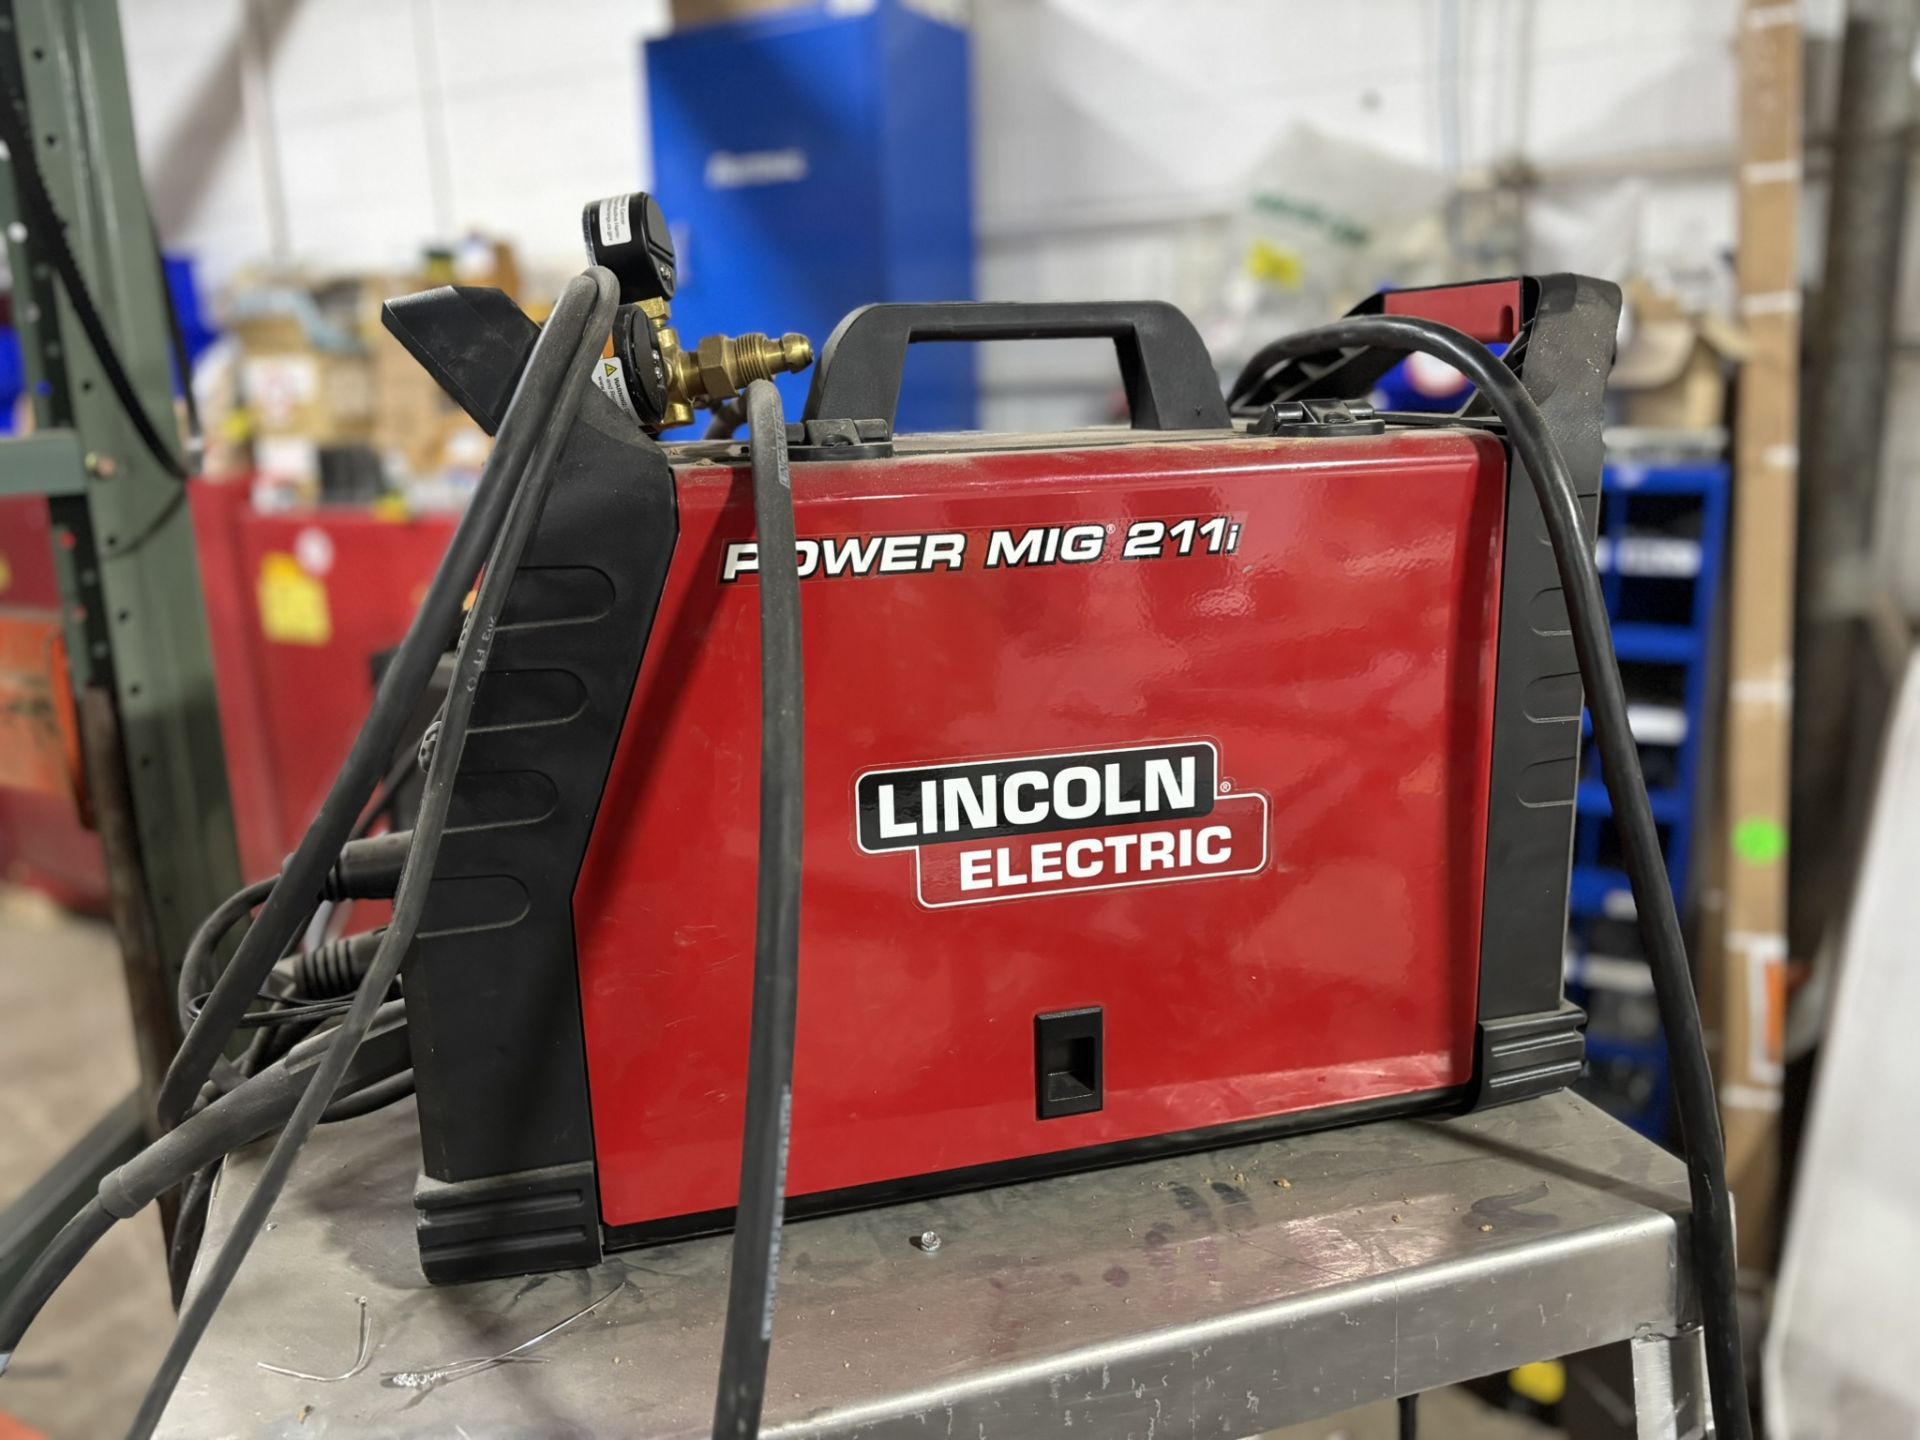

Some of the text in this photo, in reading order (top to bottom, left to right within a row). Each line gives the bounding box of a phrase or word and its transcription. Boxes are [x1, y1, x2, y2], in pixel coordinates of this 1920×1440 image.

[1121, 516, 1242, 560] 211i
[878, 756, 1196, 839] LINCOLN
[959, 825, 1233, 891] ELECTRIC
